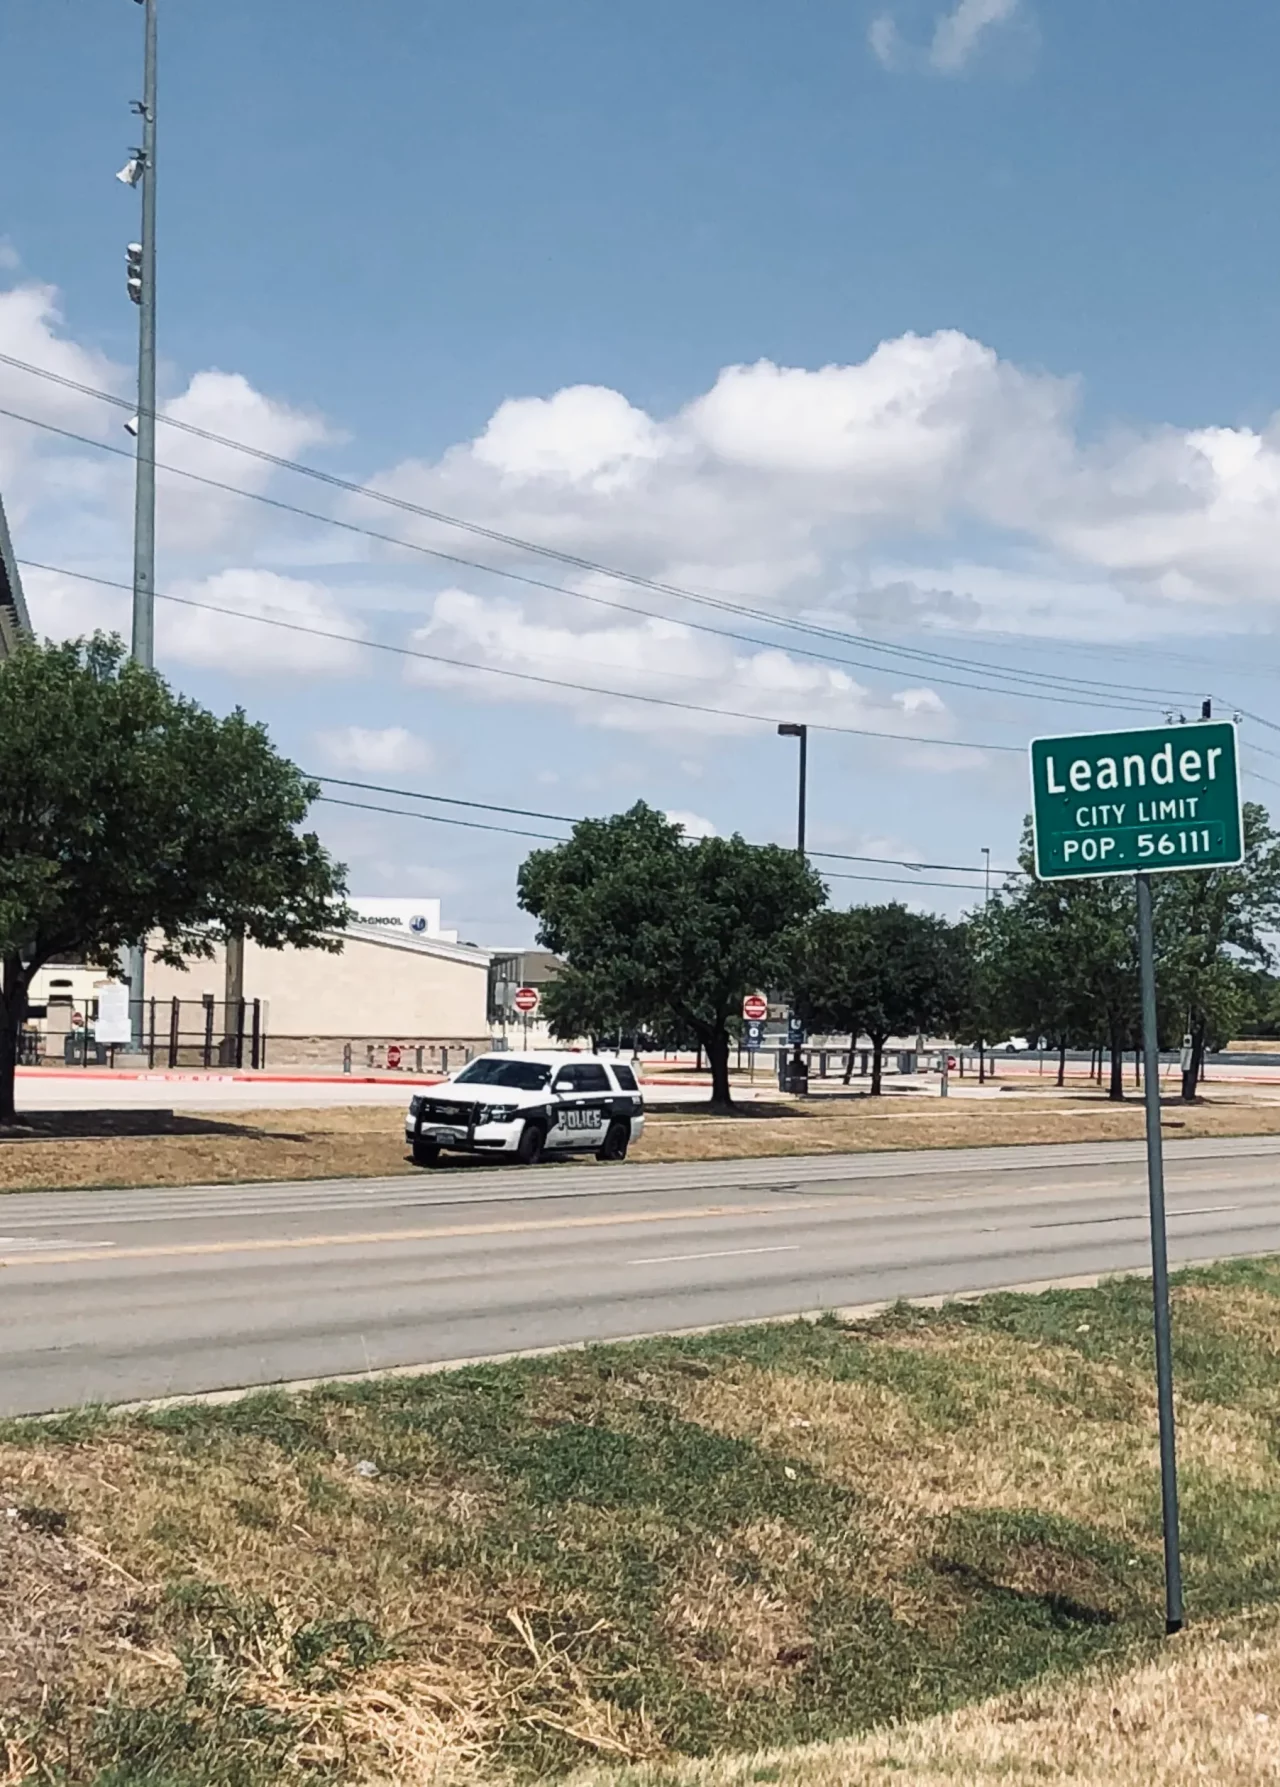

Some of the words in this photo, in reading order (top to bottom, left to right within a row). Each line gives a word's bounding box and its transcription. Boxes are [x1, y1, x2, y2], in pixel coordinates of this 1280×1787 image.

[1046, 742, 1222, 794] Leander
[1076, 804, 1126, 827] CITY
[1138, 797, 1199, 822] LIMIT
[1063, 837, 1124, 862] POP.
[1137, 830, 1210, 857] 56111
[558, 1109, 602, 1130] POLICE
